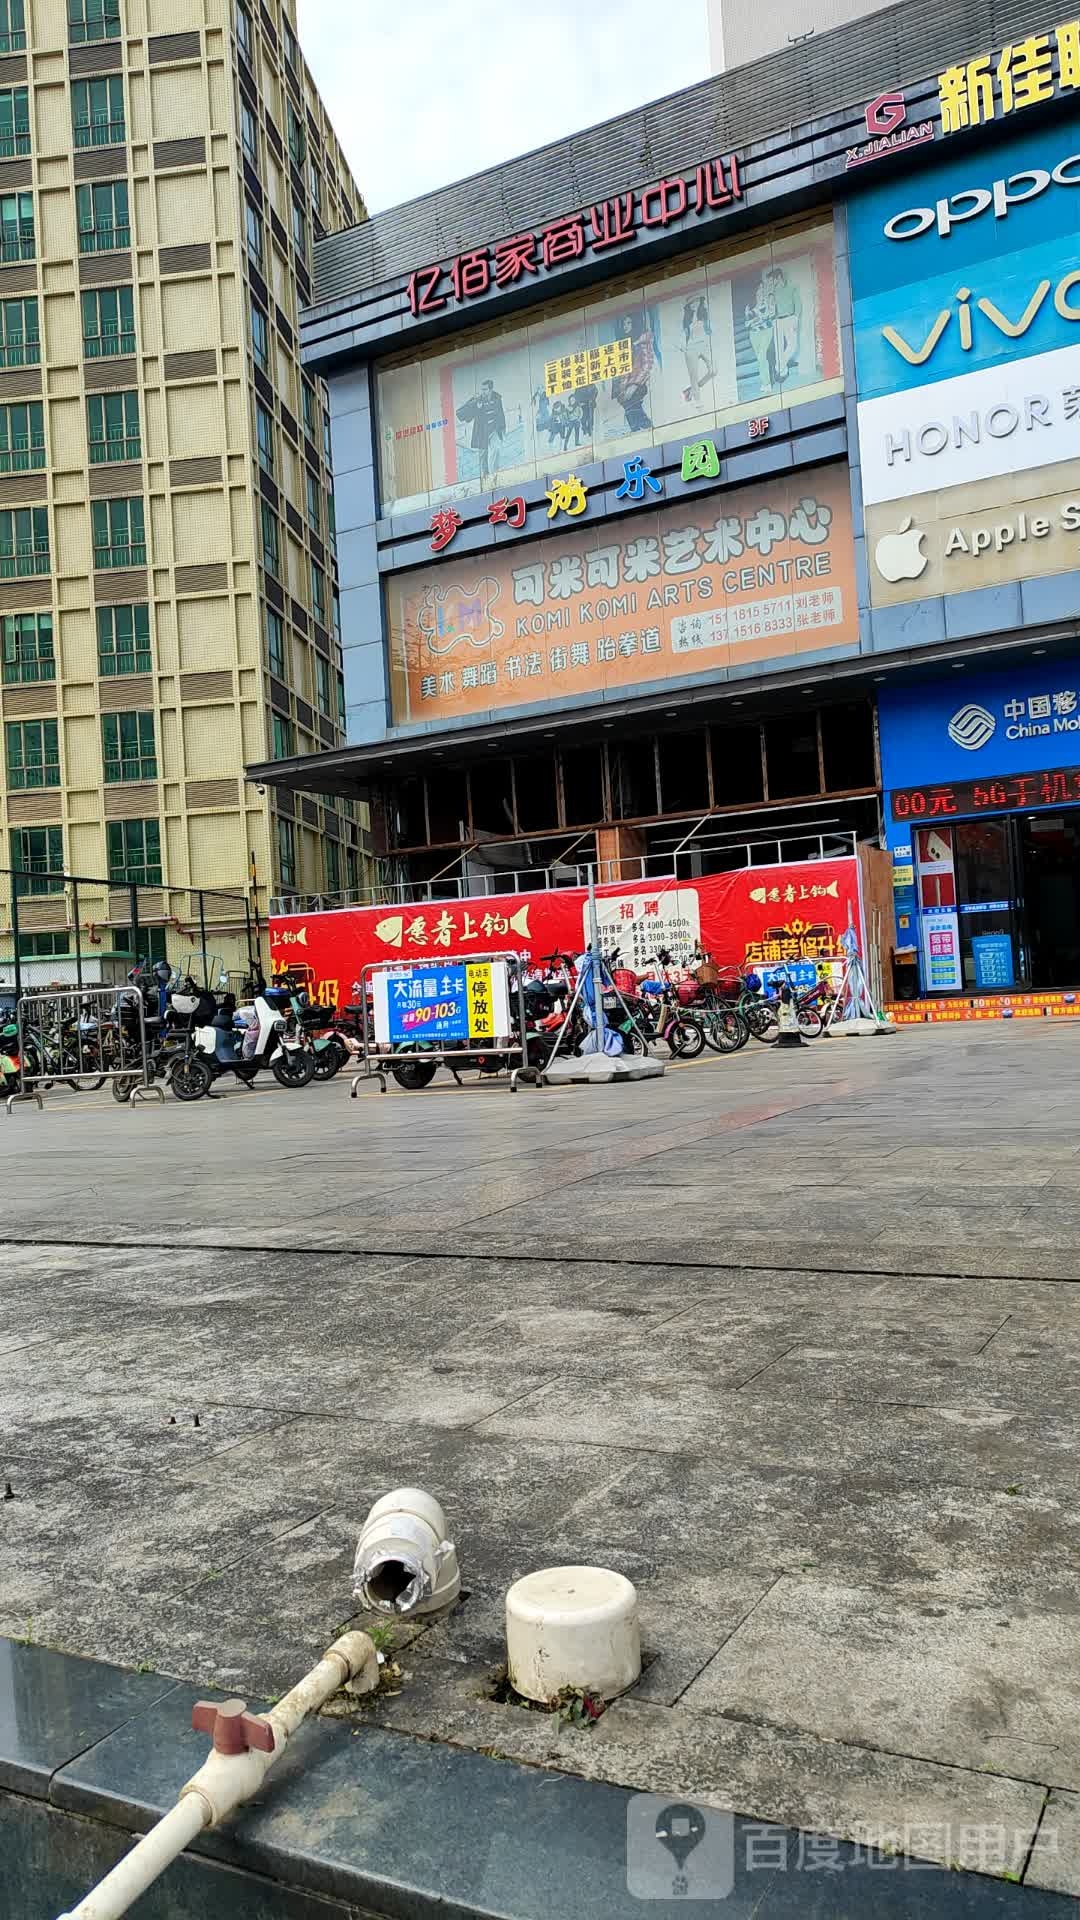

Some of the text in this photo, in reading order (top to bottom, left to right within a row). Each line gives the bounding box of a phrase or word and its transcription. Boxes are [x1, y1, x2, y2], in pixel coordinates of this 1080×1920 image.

[846, 121, 934, 162] X.JIALIAN
[405, 154, 742, 315] 亿佰家商业中心
[748, 417, 769, 437] 3F
[885, 394, 1053, 466] HONOR
[428, 439, 720, 551] 梦幻游乐园
[511, 498, 832, 605] 可米可米艺术中心
[945, 511, 1050, 557] Apple
[515, 608, 571, 638] KOMI
[579, 593, 638, 631] KOMI
[646, 575, 714, 611] ARTS
[723, 552, 833, 594] CENTRE
[709, 613, 728, 626] 151
[733, 606, 760, 621] 1815
[763, 600, 792, 615] 5711
[710, 629, 729, 642] 137
[734, 622, 761, 638] 1516
[764, 616, 793, 632] 8333
[504, 651, 542, 680] 书法
[549, 640, 589, 672] 街舞
[597, 626, 662, 662] 跆拳道
[1006, 722, 1050, 740] China
[404, 910, 509, 947] 愿者上钩
[619, 900, 659, 920] 招聘
[394, 976, 464, 999] 大流量主卡
[468, 968, 489, 978] 电动车
[472, 981, 489, 1033] 停放处
